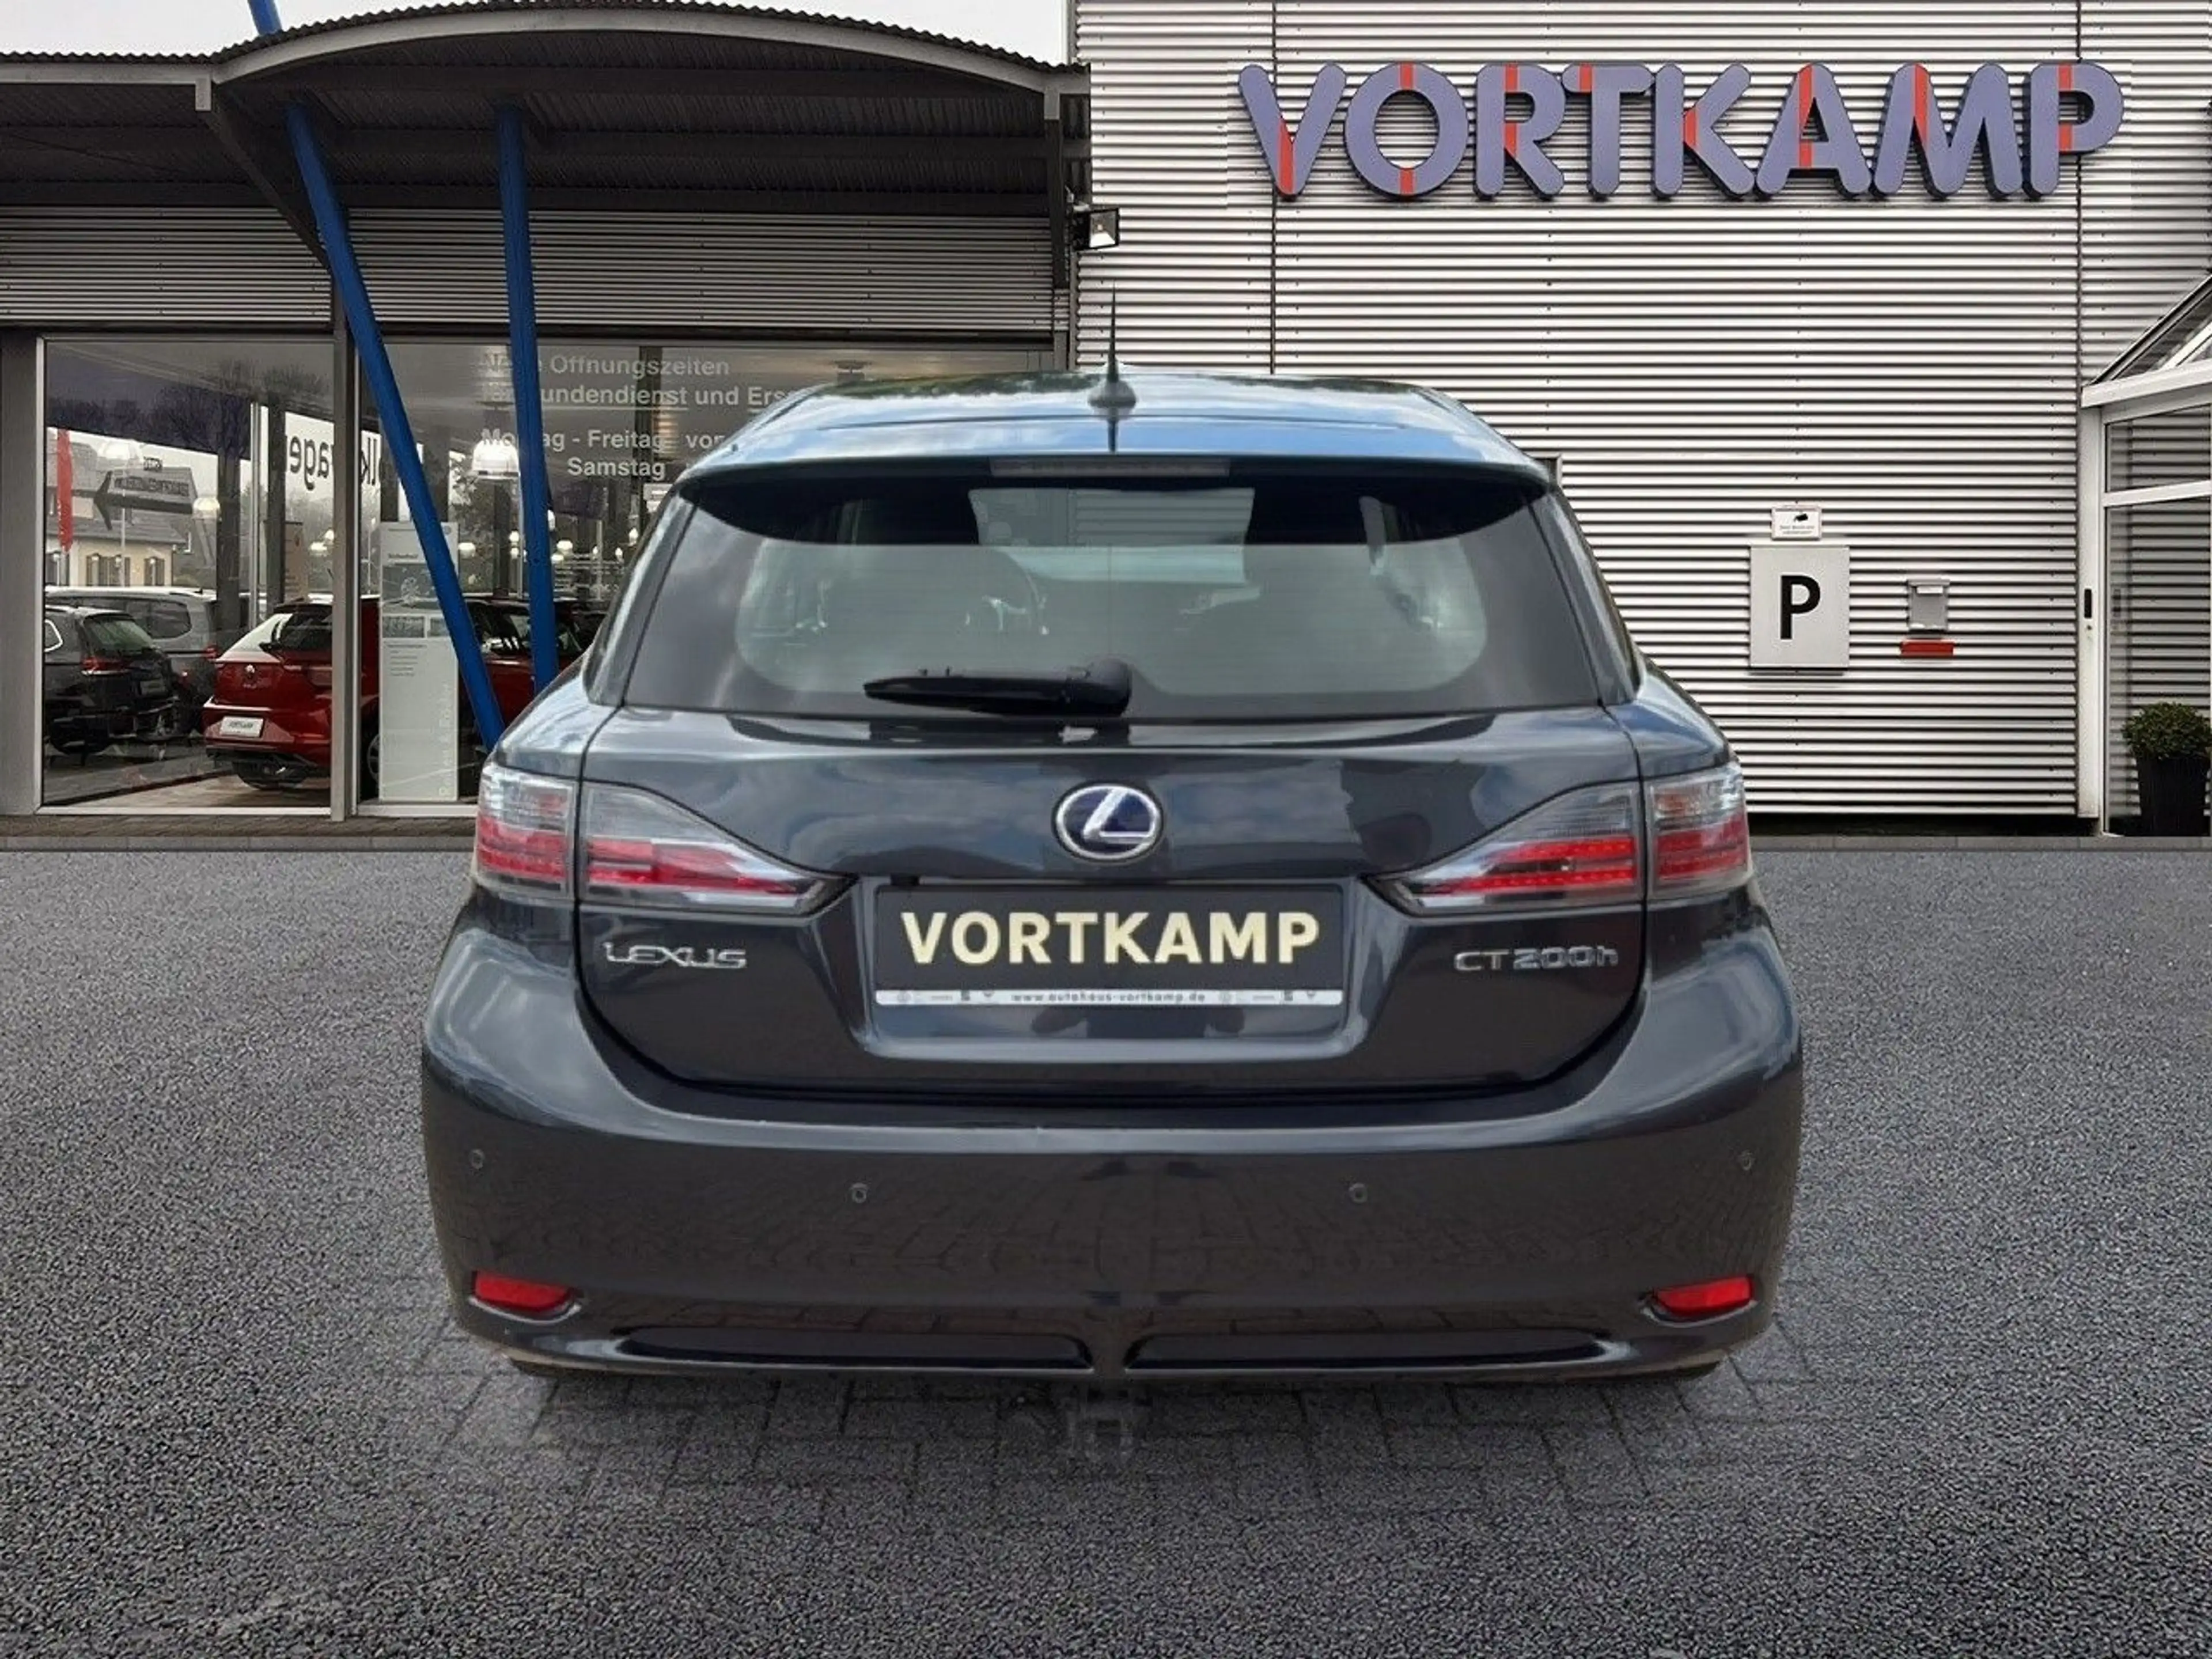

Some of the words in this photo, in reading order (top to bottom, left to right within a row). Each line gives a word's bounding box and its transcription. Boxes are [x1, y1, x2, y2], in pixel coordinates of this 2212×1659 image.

[1238, 62, 2126, 197] VORTKAMP
[540, 384, 688, 404] undendienst
[695, 385, 740, 406] und
[482, 429, 565, 452] Moag
[588, 429, 664, 452] Freitag
[567, 457, 665, 480] Samstag
[1780, 574, 1821, 640] P
[901, 911, 1320, 965] VORTKAMP
[604, 942, 747, 969] LEXUS
